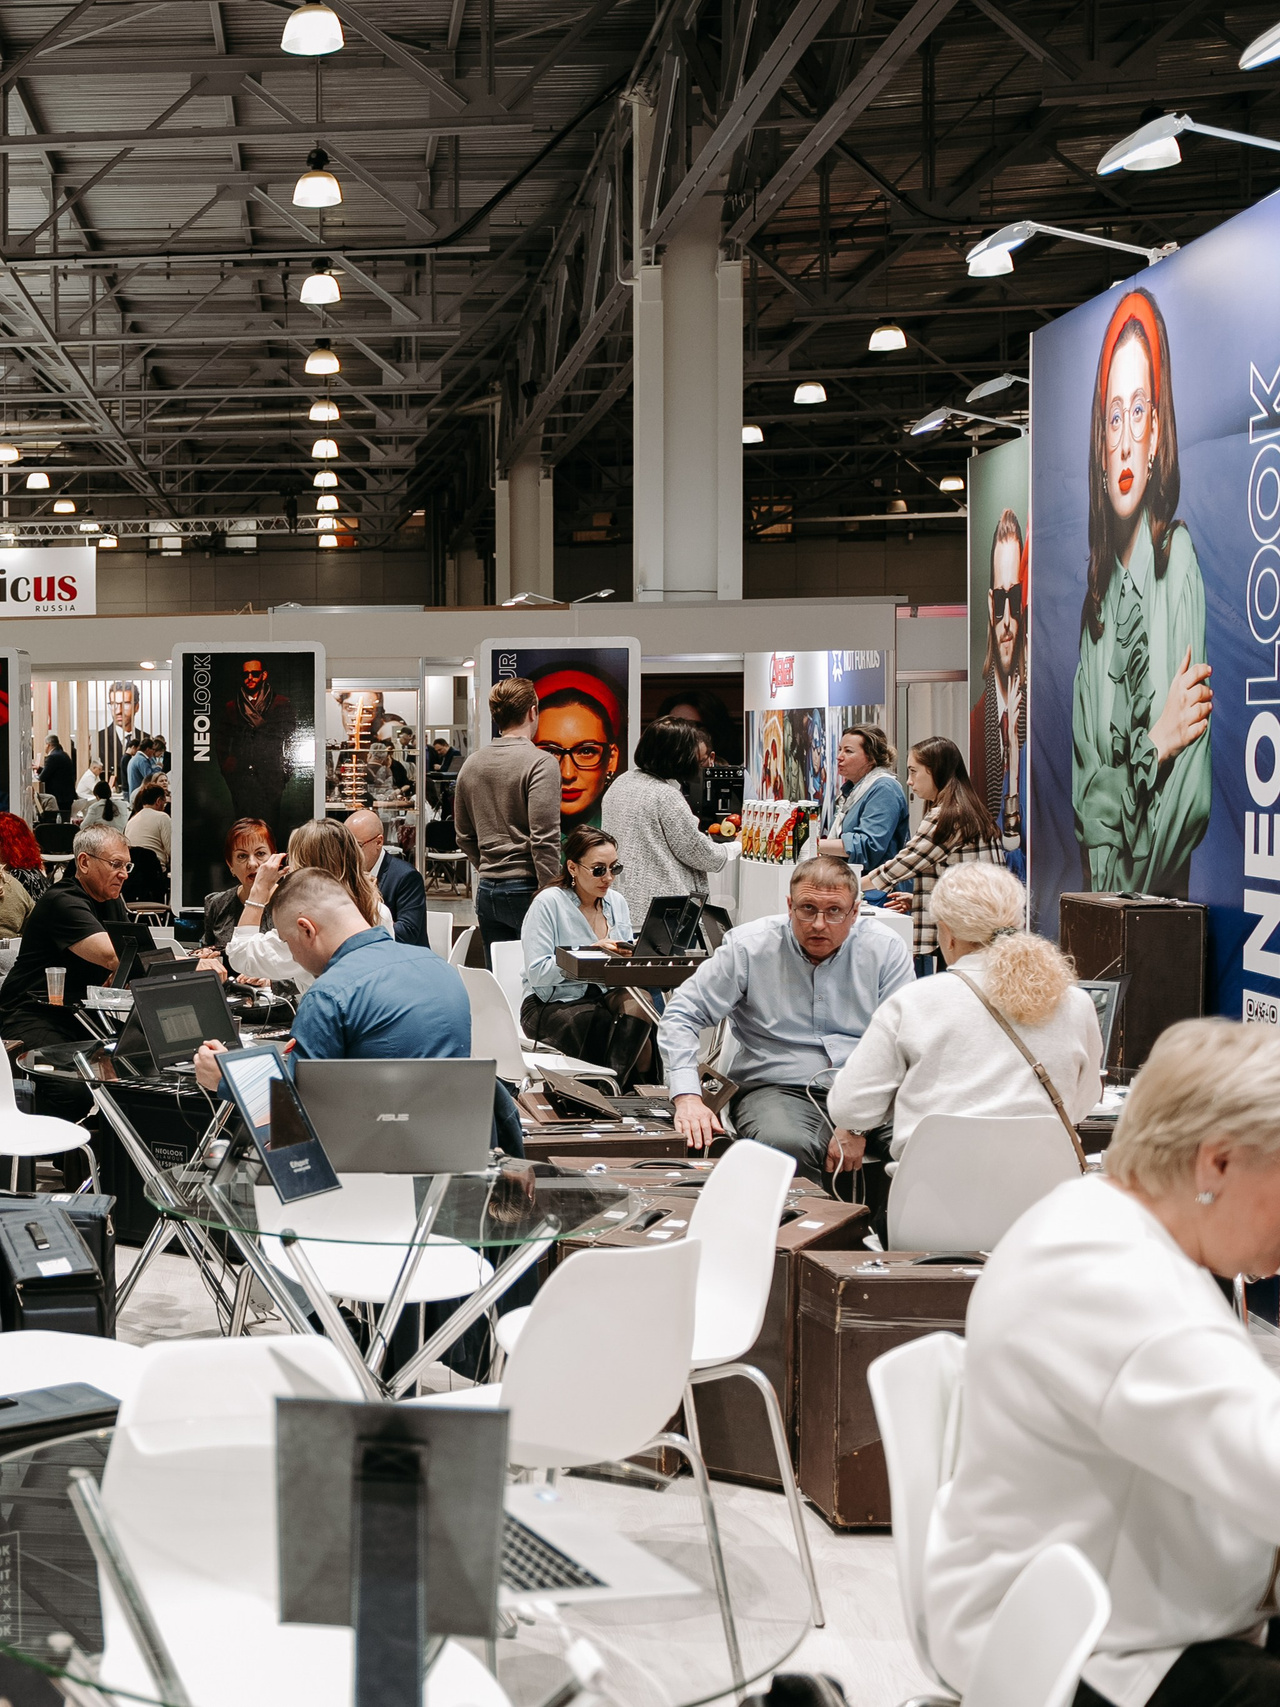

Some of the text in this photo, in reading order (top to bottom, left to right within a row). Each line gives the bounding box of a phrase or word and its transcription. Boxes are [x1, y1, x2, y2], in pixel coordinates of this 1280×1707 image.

[35, 604, 76, 612] RUSSIA
[1242, 360, 1280, 971] NEOLOOK
[193, 654, 211, 762] NEOLOOK
[376, 1113, 410, 1121] ASUS
[155, 1148, 183, 1157] NEOLOOK
